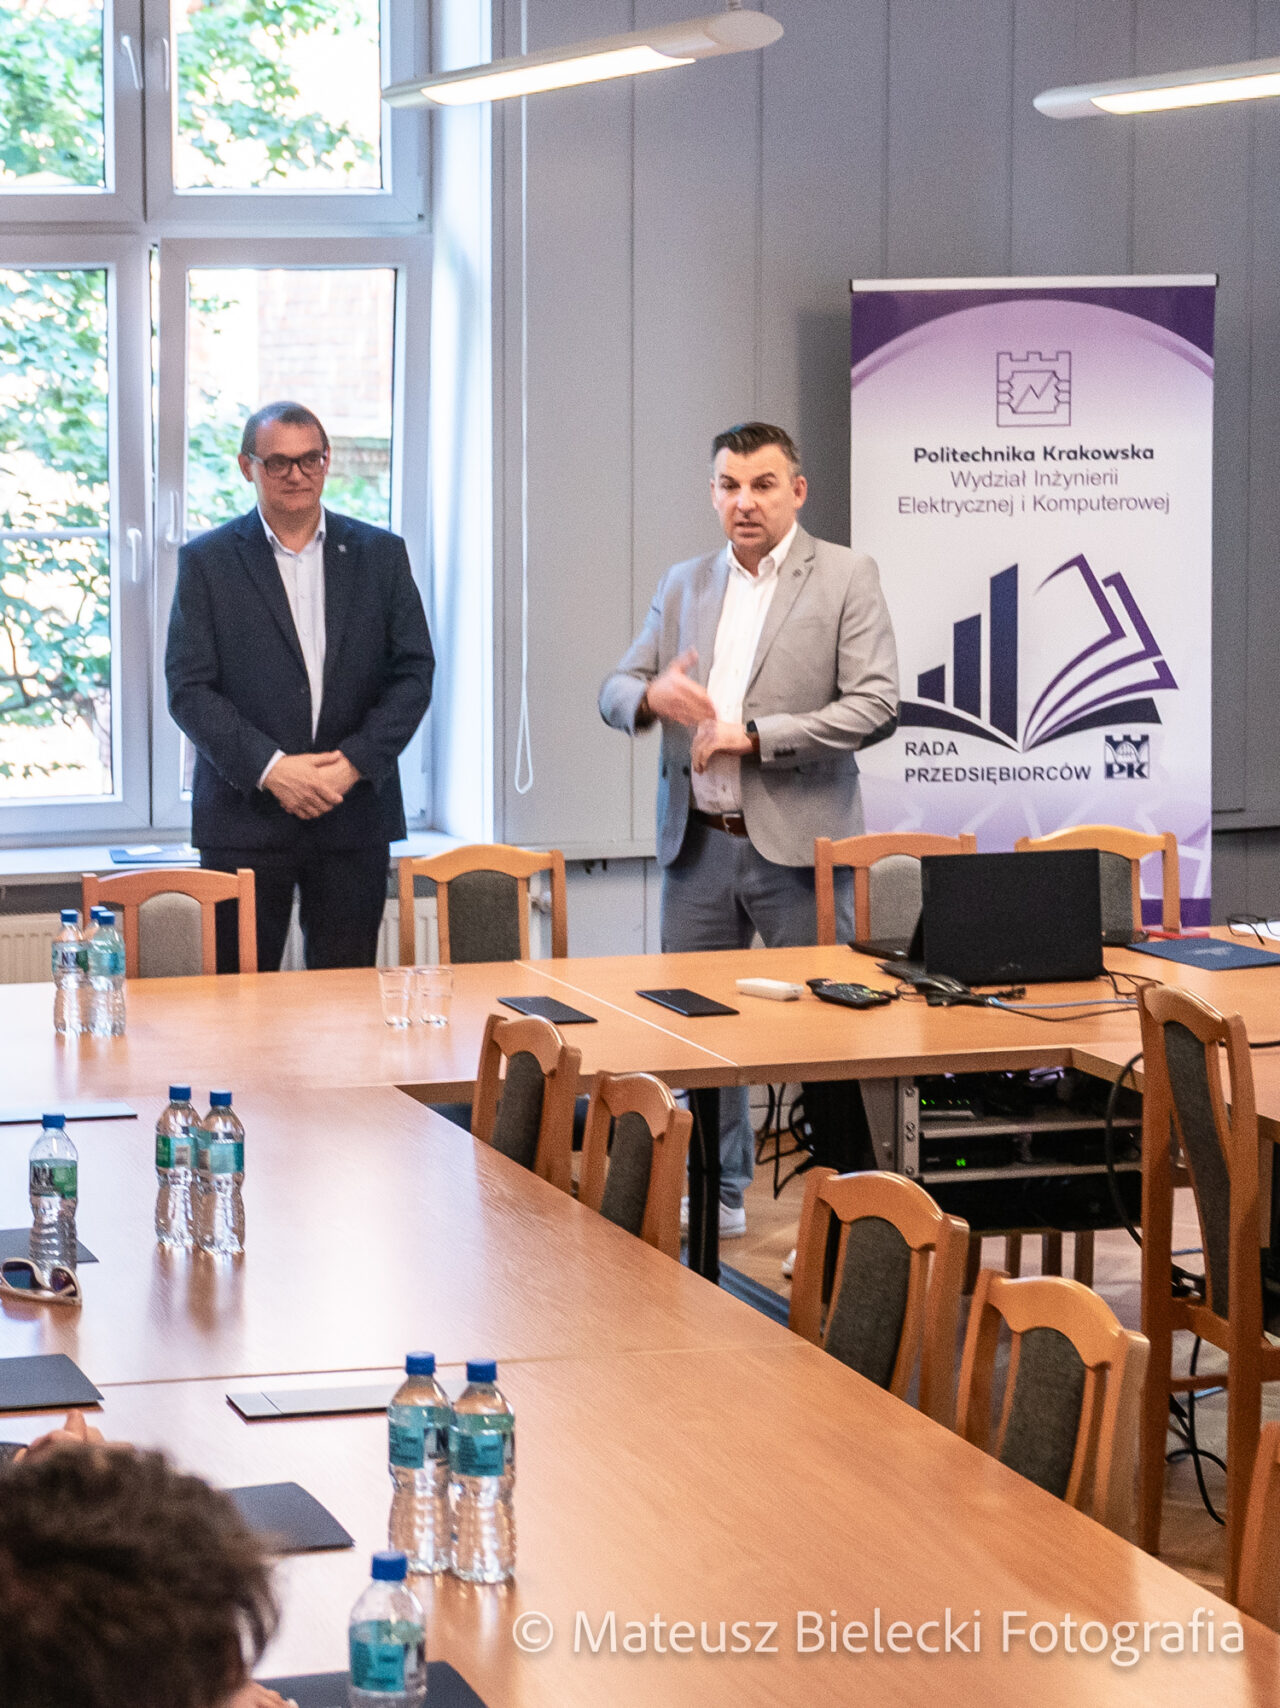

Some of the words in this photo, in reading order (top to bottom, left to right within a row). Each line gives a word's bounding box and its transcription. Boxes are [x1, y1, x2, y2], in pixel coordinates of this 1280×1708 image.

[913, 446, 1036, 464] Politechnika
[1043, 444, 1155, 462] Krakowska
[951, 470, 1027, 492] Wydział
[1034, 468, 1119, 490] Inżynierii
[898, 495, 1014, 517] Elektrycznej
[1032, 493, 1170, 515] Komputerowej
[905, 741, 959, 757] RADA
[905, 763, 1092, 785] PRZEDSIĘBIORCÓW
[1105, 762, 1150, 779] PK
